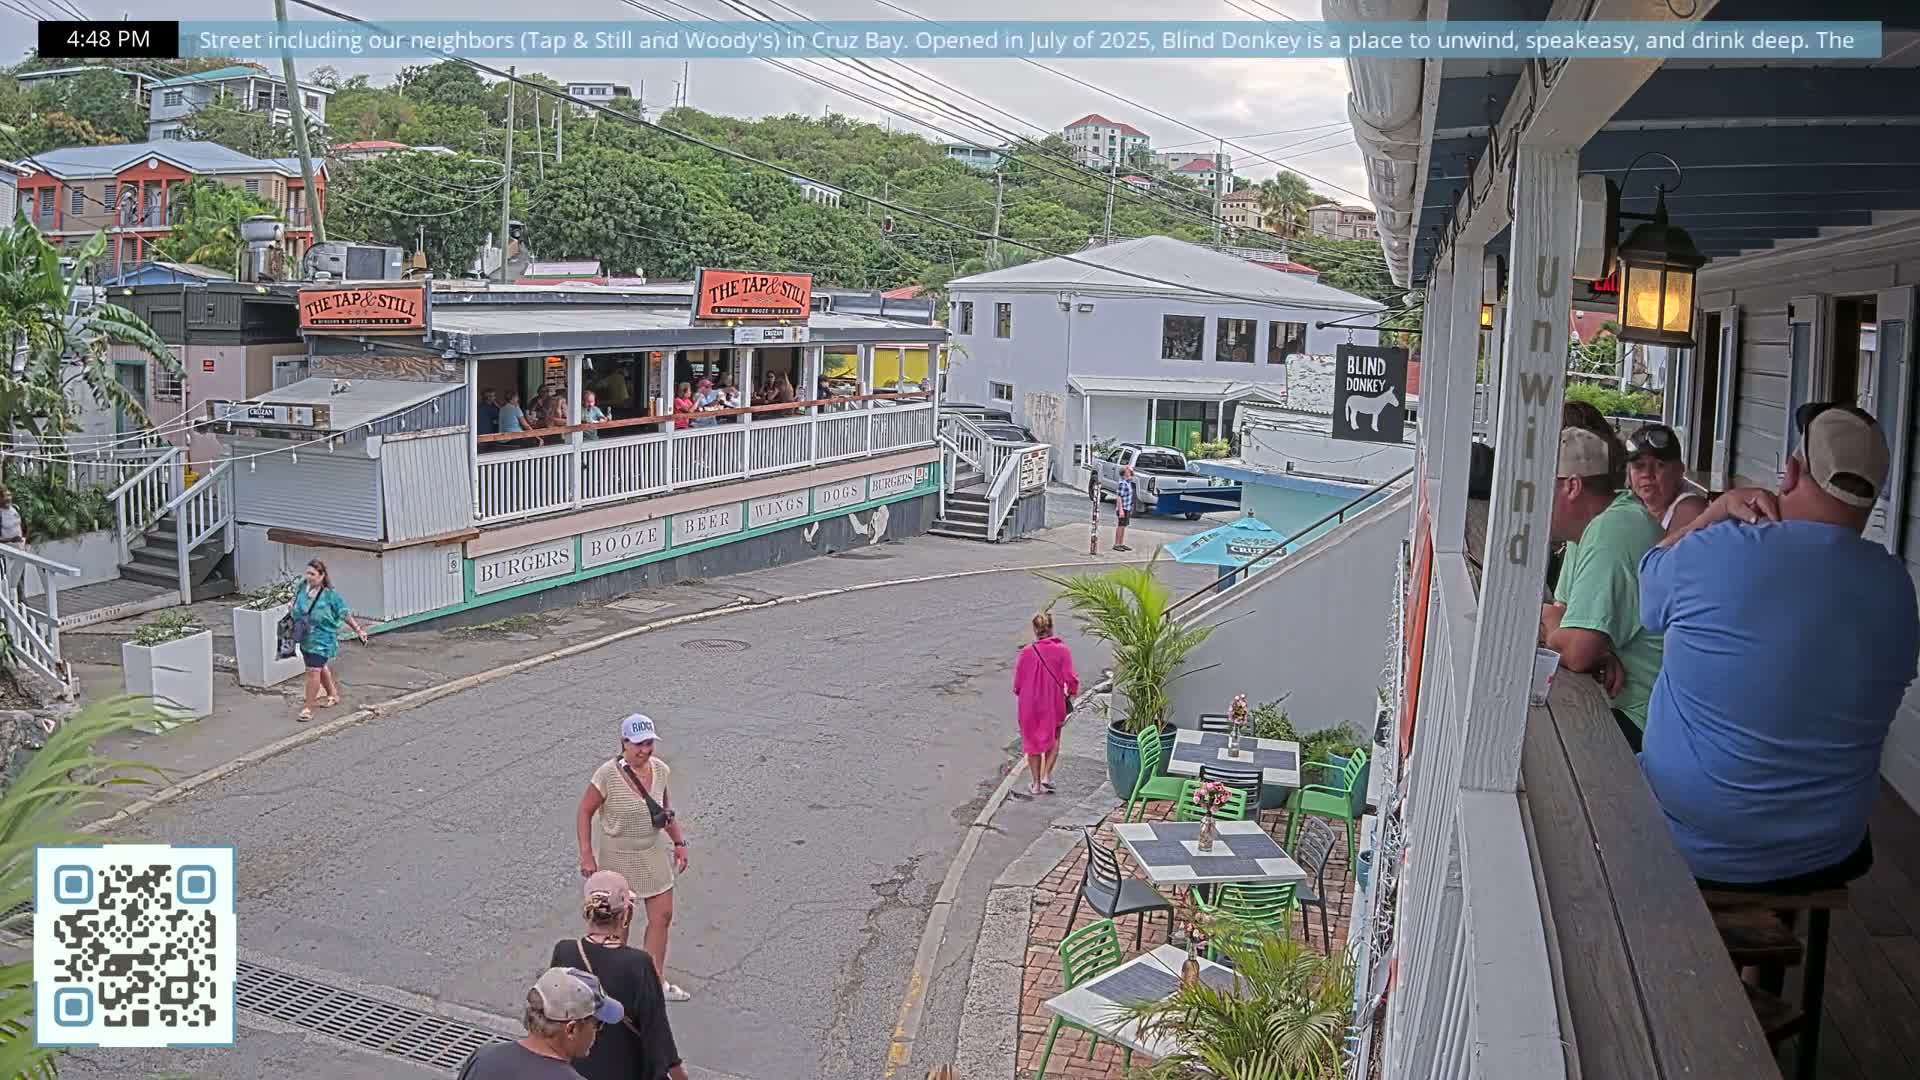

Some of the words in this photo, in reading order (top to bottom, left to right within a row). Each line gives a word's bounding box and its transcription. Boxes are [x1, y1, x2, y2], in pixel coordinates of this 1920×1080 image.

[709, 280, 740, 304] THE
[742, 276, 768, 294] TAP
[766, 277, 781, 295] &
[780, 280, 806, 307] STILL
[305, 296, 332, 317] THE
[333, 292, 361, 308] TAP
[360, 290, 377, 307] &
[378, 293, 416, 317] STILL
[1347, 355, 1386, 376] BLIND
[1346, 377, 1386, 393] DONKEY
[871, 471, 913, 492] BURGERS
[823, 484, 858, 503] DOGS
[754, 497, 804, 518] WINGS
[684, 511, 730, 534] BEER
[591, 527, 658, 556] BOOZE
[480, 548, 570, 582] BURGERS
